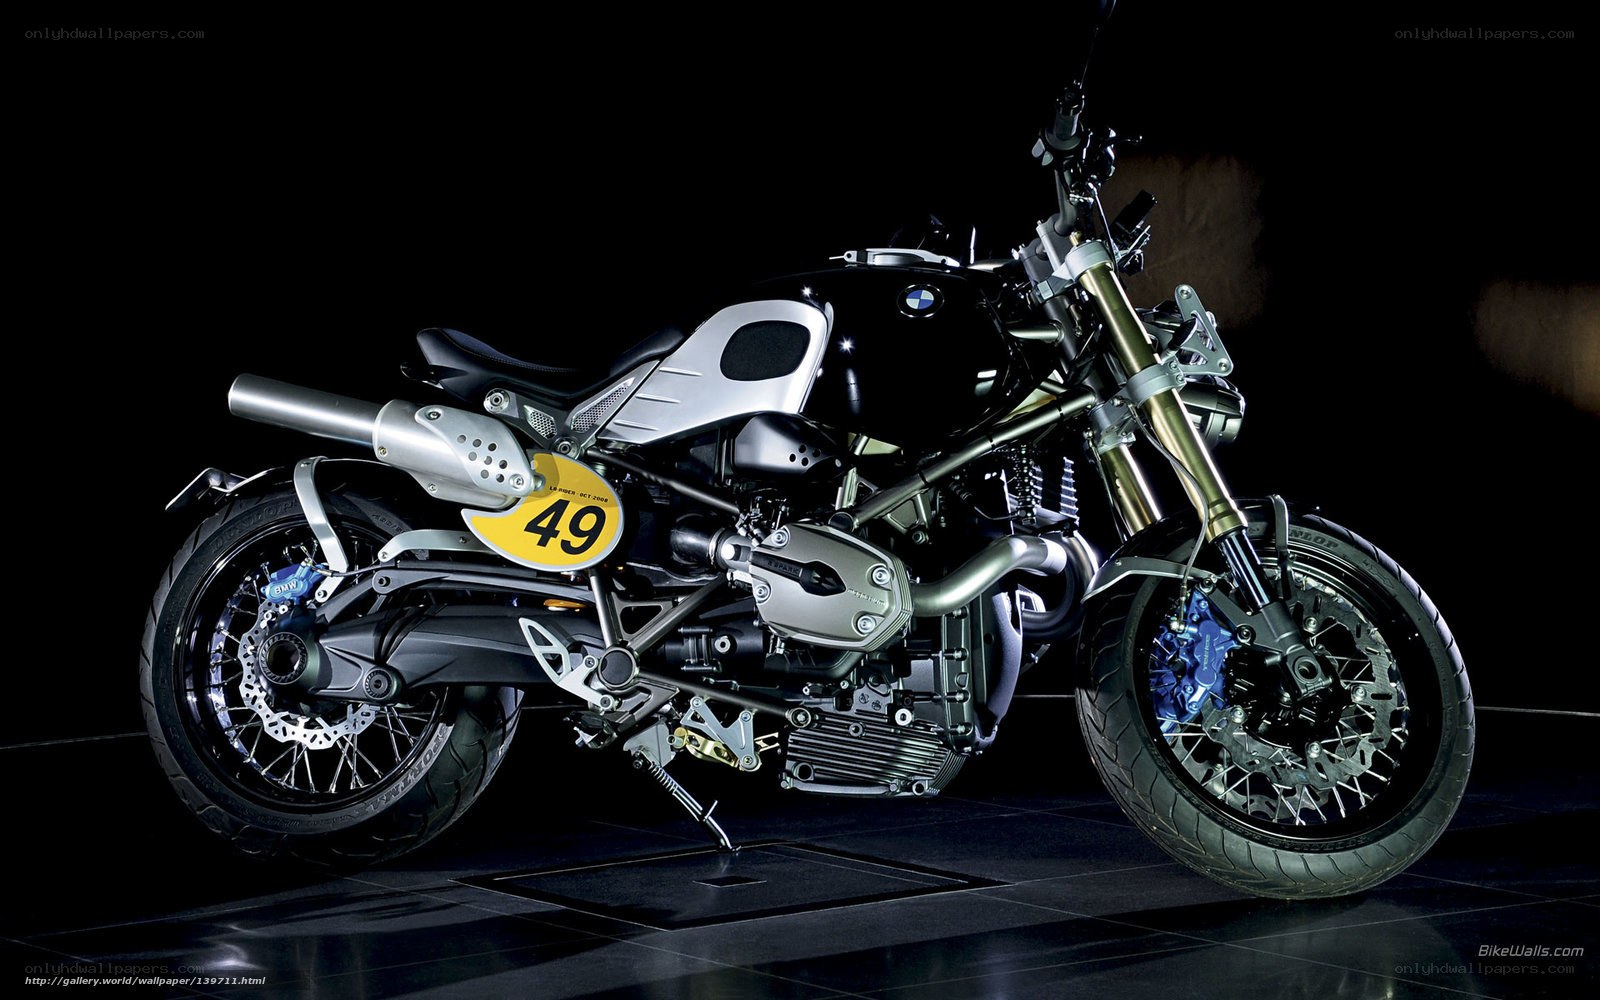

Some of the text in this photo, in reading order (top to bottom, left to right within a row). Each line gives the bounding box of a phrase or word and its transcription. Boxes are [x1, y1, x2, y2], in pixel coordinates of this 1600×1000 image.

[523, 498, 607, 556] 49
[1289, 528, 1340, 548] NLOP
[274, 580, 298, 595] BMW
